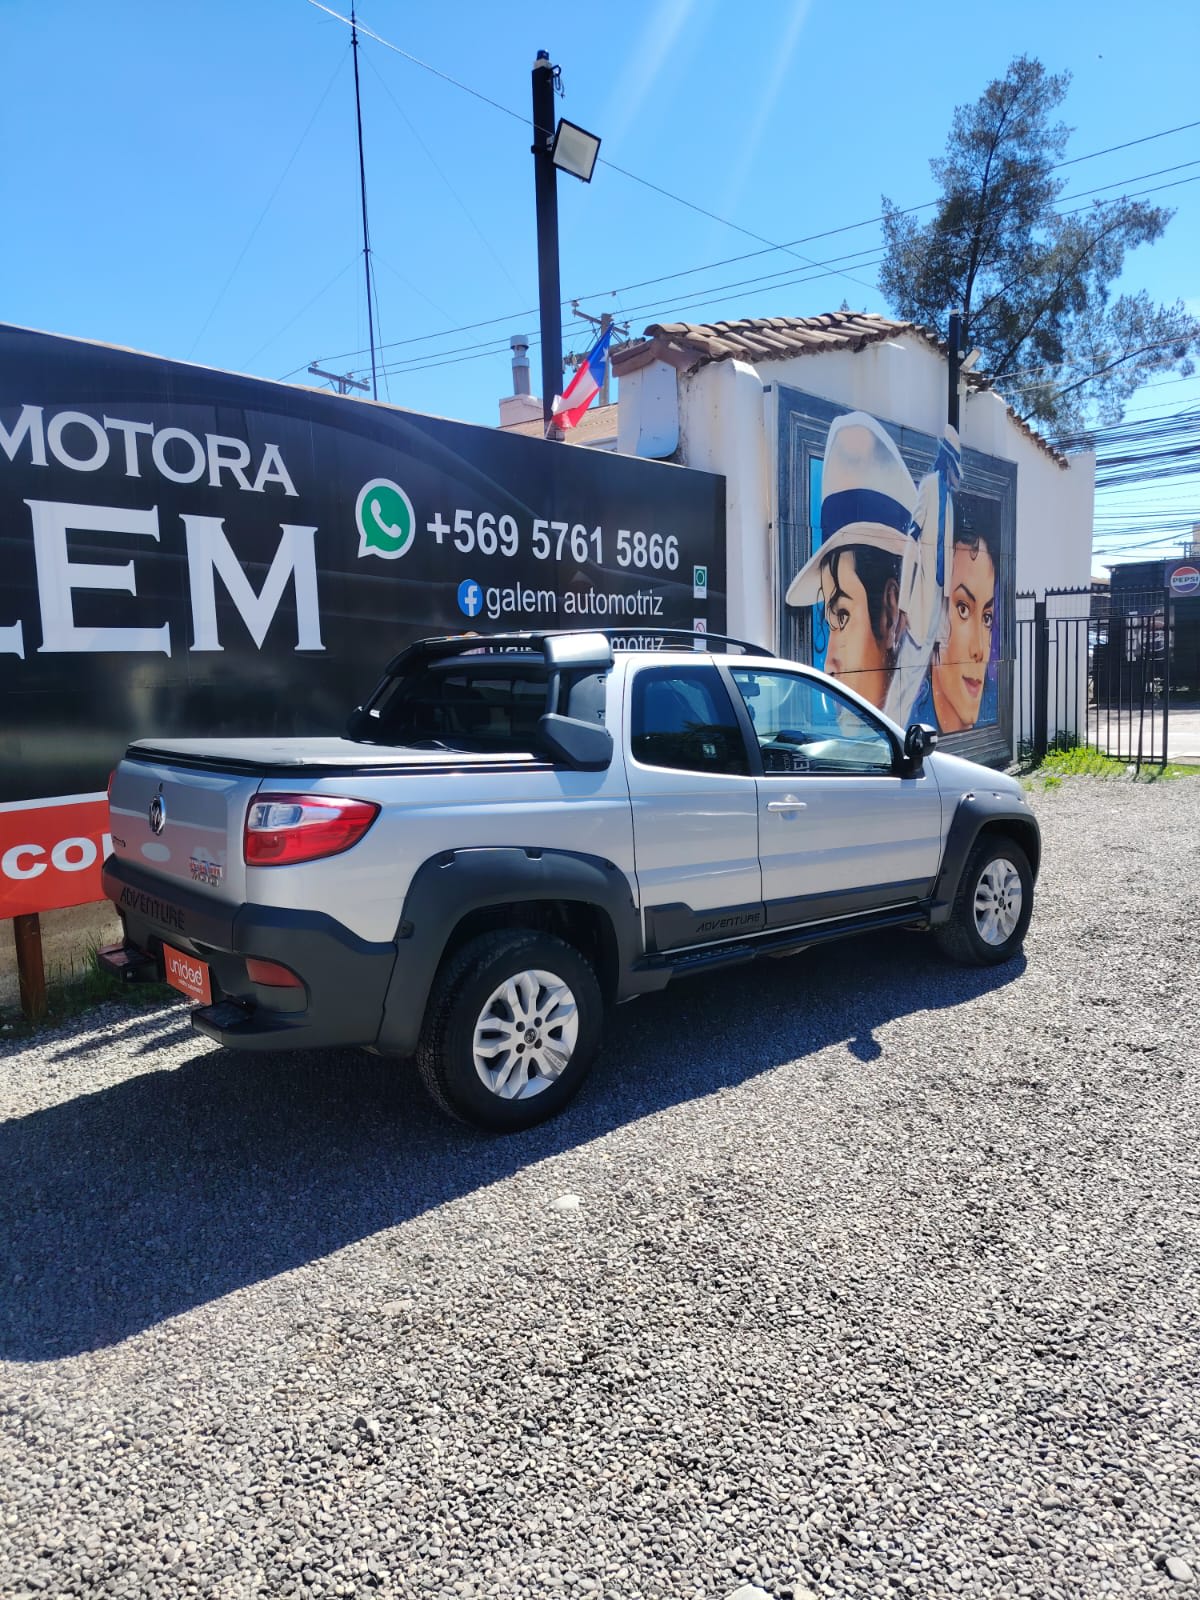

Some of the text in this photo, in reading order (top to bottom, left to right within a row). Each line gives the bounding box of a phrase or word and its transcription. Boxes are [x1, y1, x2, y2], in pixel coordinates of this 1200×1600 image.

[426, 509, 679, 571] +569 5761 5866
[486, 581, 664, 619] galem automotriz
[696, 913, 761, 933] ADVENTURE
